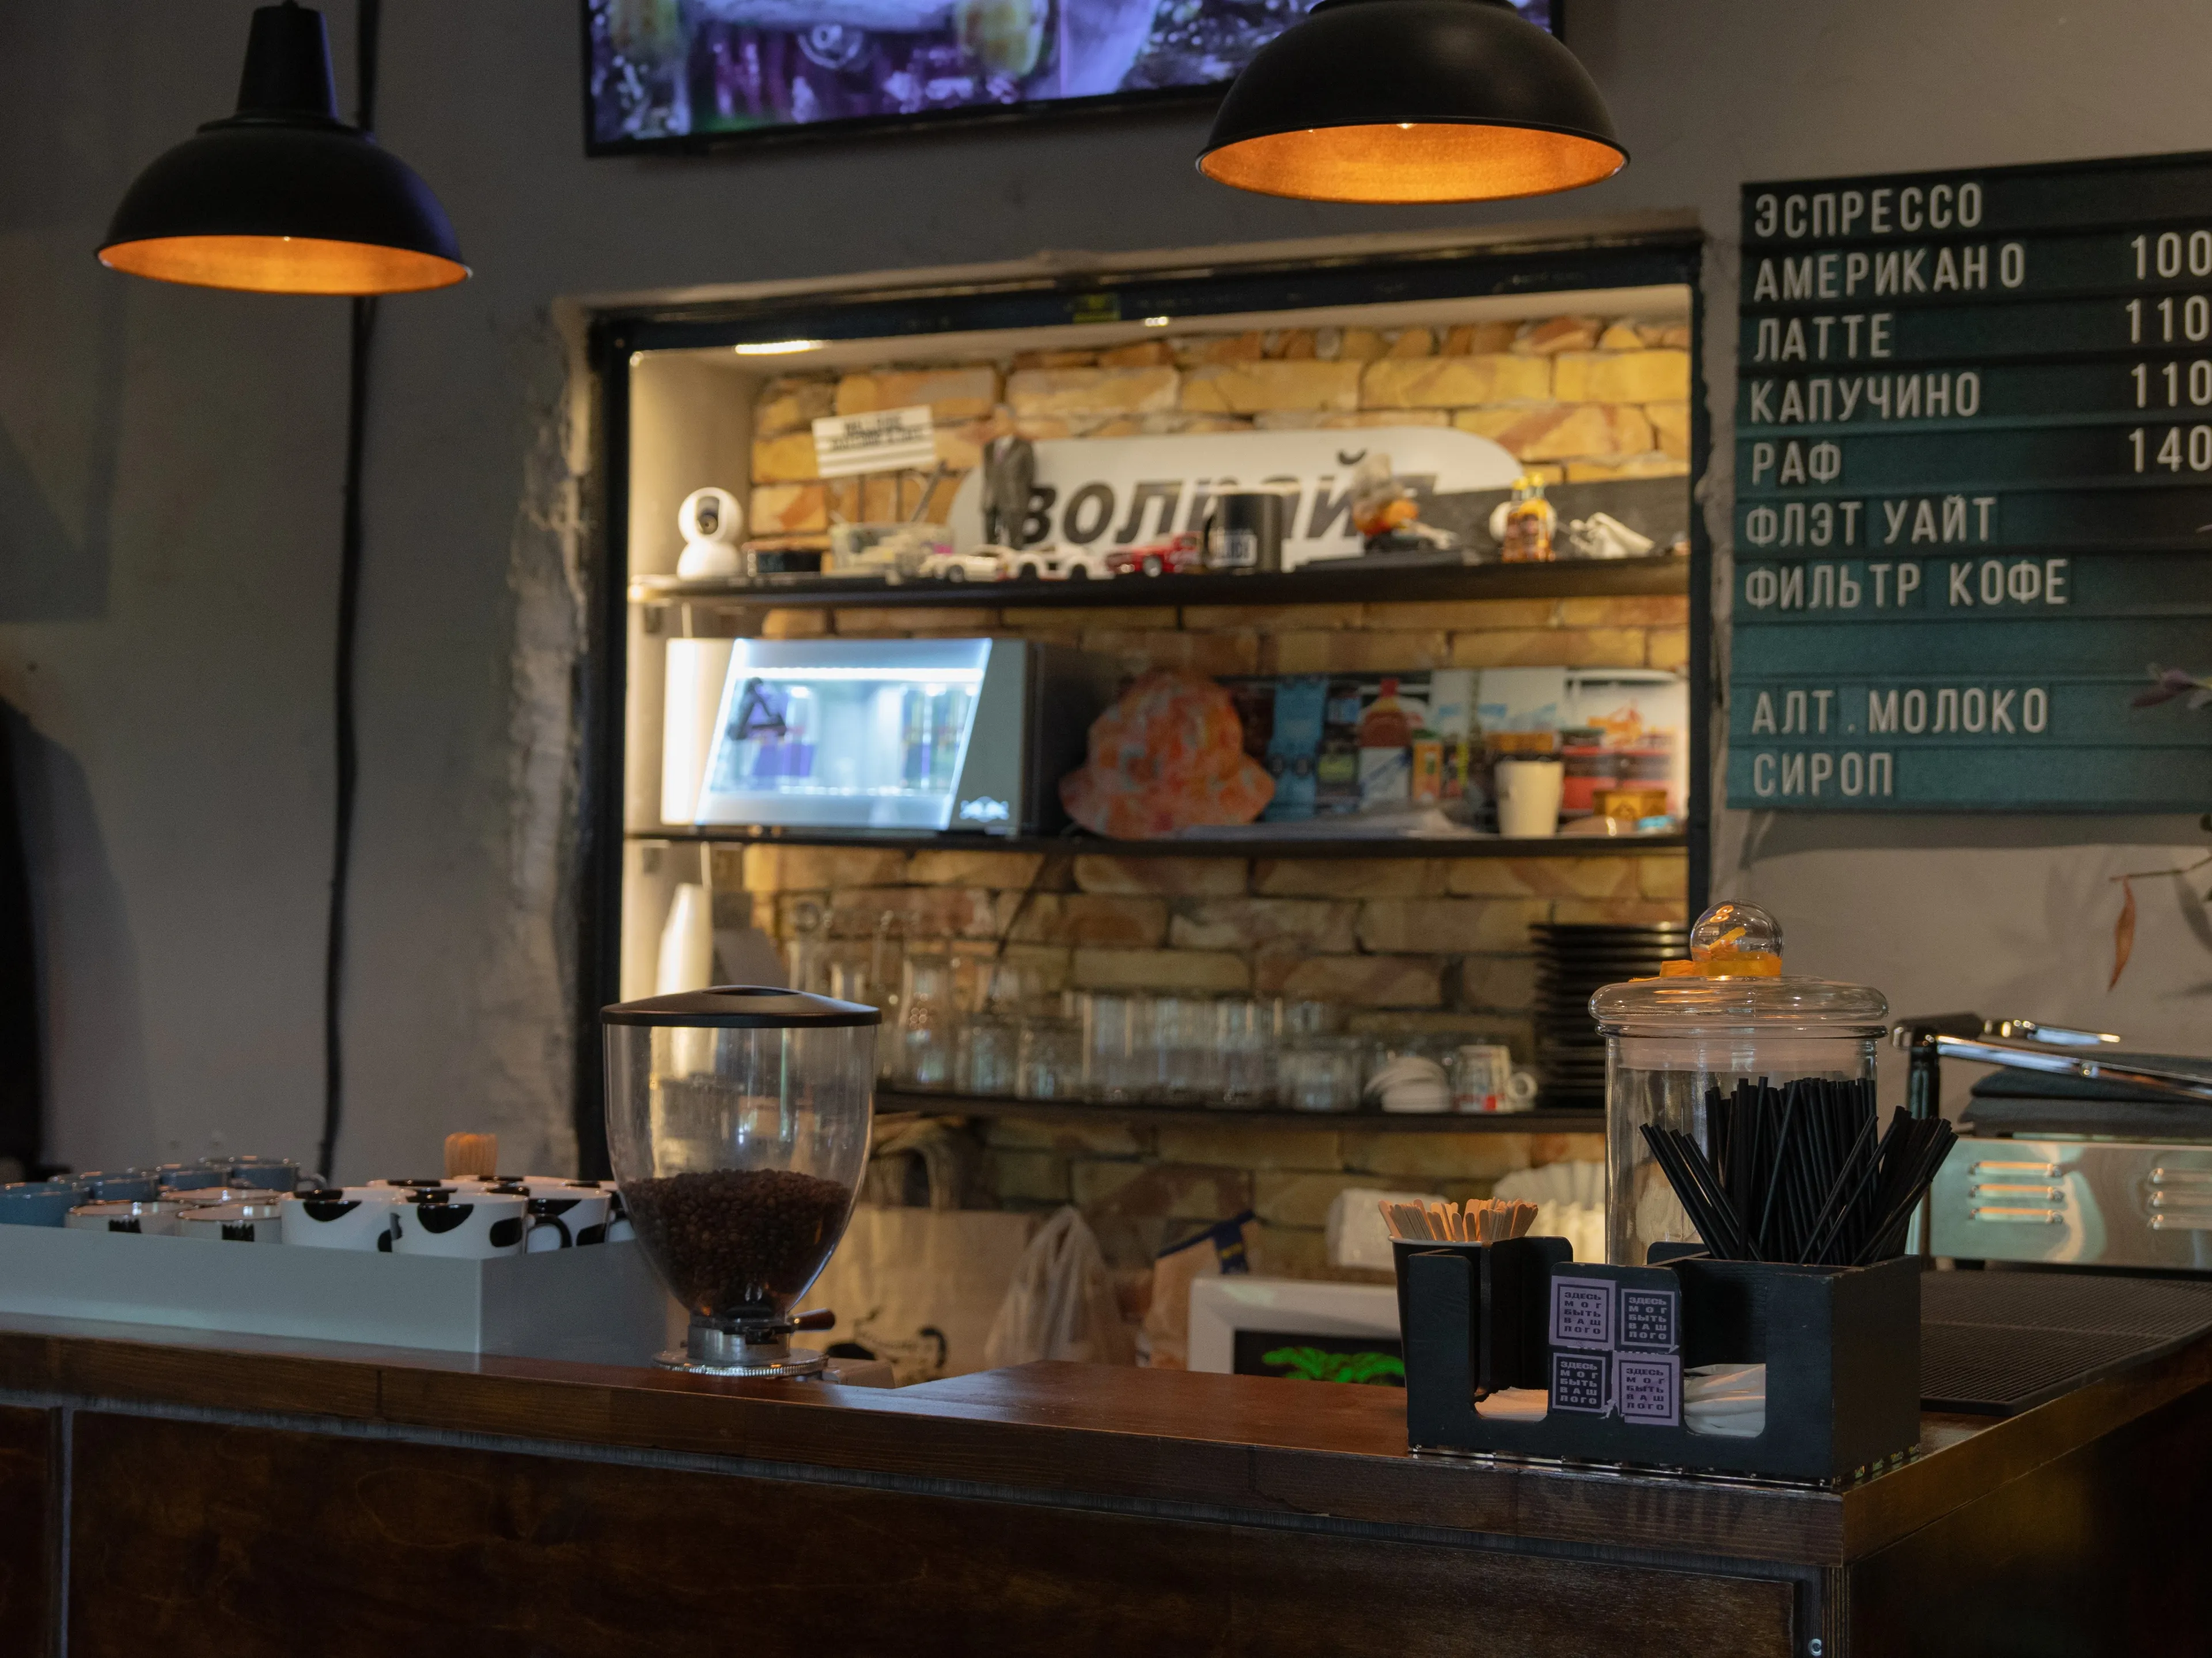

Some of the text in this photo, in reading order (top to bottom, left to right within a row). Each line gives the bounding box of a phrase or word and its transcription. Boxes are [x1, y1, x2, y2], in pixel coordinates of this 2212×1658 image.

[1754, 181, 1983, 239] ЭСПРЕССО
[1753, 229, 2212, 301] АМЕРИКАНО 100
[1753, 294, 2210, 362] ЛАТТЕ 110
[1750, 359, 2212, 424] КАПУЧИНО 110
[1751, 425, 2212, 486] РАФ 140
[1745, 494, 1997, 547] ФЛЭТ УАЙТ
[1745, 558, 2069, 610] ФИЛЬТР КОФЕ
[1868, 687, 2048, 734] МОЛОКО
[1752, 751, 1894, 797] СИРОП
[1563, 1309, 1601, 1318] БЫТЬ
[1564, 1292, 1601, 1300] ЗДЕСЬ
[1628, 1297, 1667, 1305] ЗДЕСЬ
[1628, 1314, 1667, 1323] БЫТЬ
[1559, 1378, 1597, 1387] БЫТЬ
[1560, 1361, 1598, 1371] ЗДЕСЬ
[1626, 1368, 1664, 1376] ЗДЕСЬ
[1626, 1385, 1664, 1394] БЫТЬ
